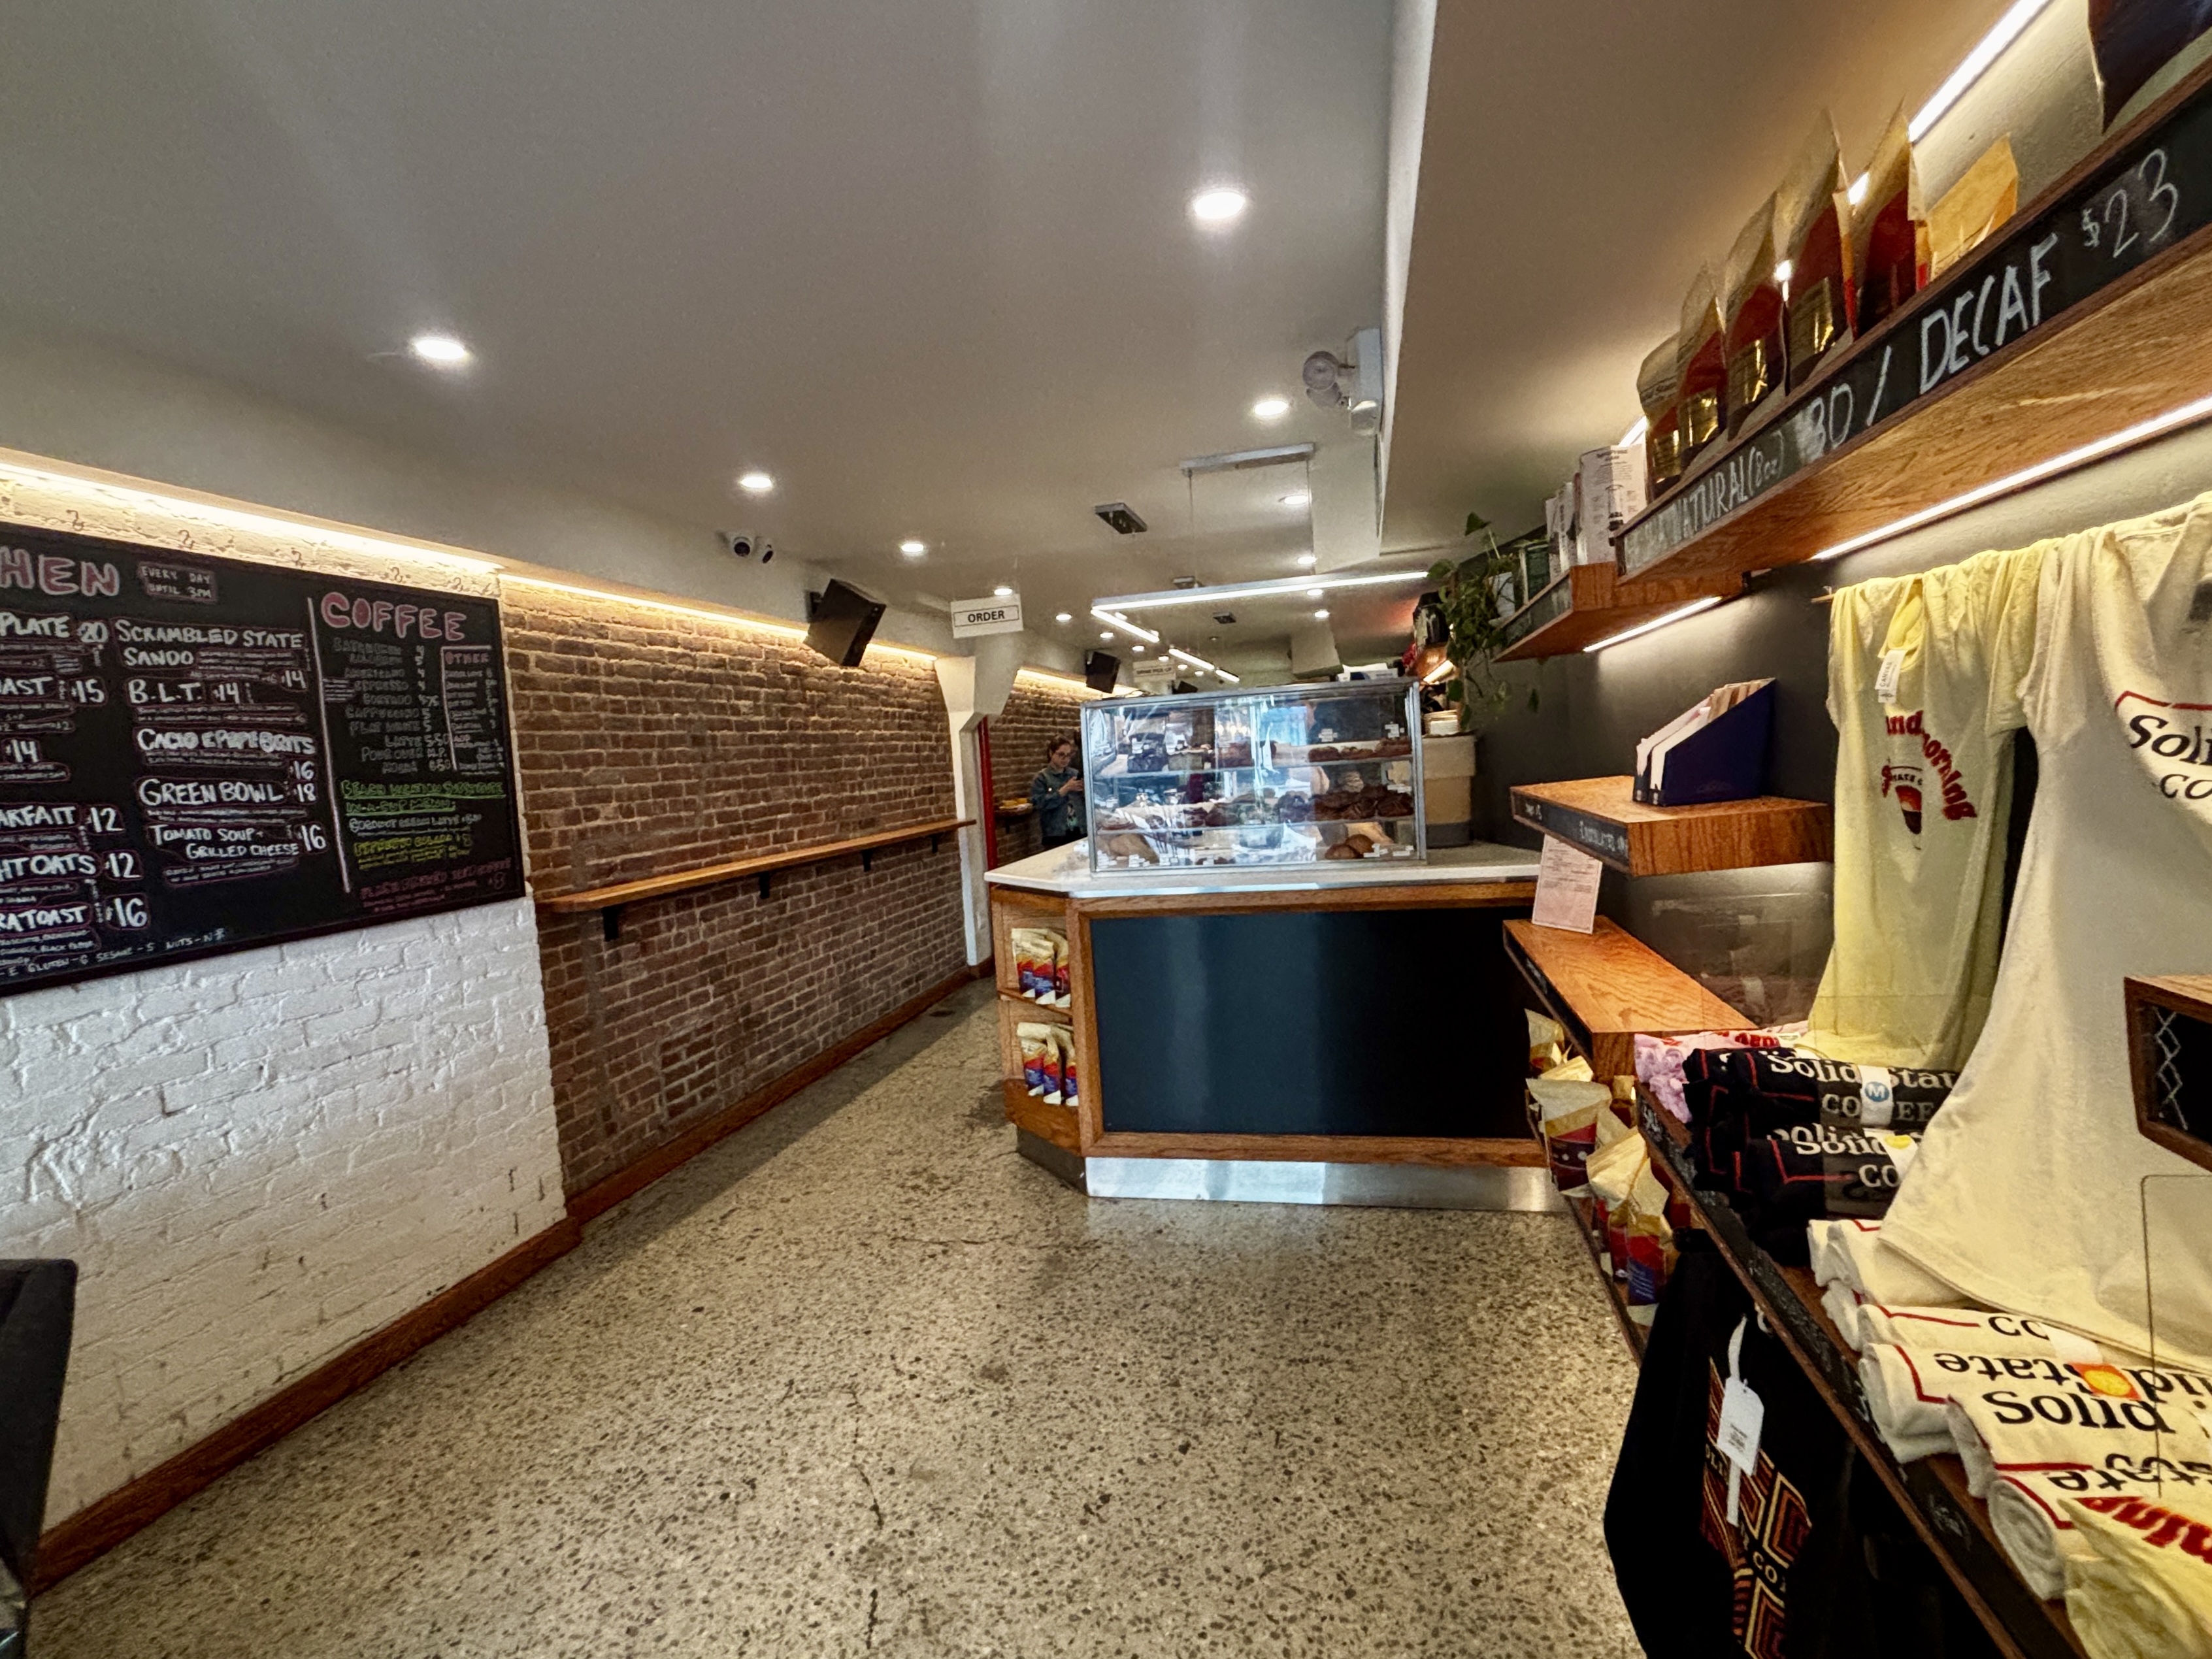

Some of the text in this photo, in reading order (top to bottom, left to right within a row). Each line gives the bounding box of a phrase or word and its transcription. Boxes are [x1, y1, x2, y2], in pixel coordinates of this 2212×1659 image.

[1920, 232, 2058, 395] DECAF
[2082, 148, 2179, 259] $23
[141, 566, 210, 583] EVERY DAY
[147, 583, 212, 599] UNTIL 3PM
[0, 612, 70, 638] PLATE
[321, 591, 467, 641] COFFEE
[968, 610, 1005, 623] ORDER
[115, 619, 304, 649] SCRAMBLED STATE
[124, 647, 194, 666] SANDO
[445, 651, 489, 665] OTHER
[354, 680, 409, 692] ESPRESSO
[363, 693, 412, 705] CORTADO
[345, 704, 420, 719] CAPPUCCINO
[349, 720, 382, 736] FLAT
[137, 728, 199, 751] CACIO
[384, 734, 423, 747] LATTE
[361, 746, 393, 762] POUR
[394, 747, 424, 759] OVER
[139, 778, 217, 806] GREEN
[219, 781, 284, 803] BOWL
[148, 824, 212, 846] TOMATO
[216, 827, 255, 842] SOUP
[186, 842, 300, 860] GRILLED CHEESE
[29, 853, 97, 876] OATS
[18, 905, 88, 929] TOAST
[1767, 1053, 1862, 1084] Solid
[1868, 1085, 1885, 1100] M
